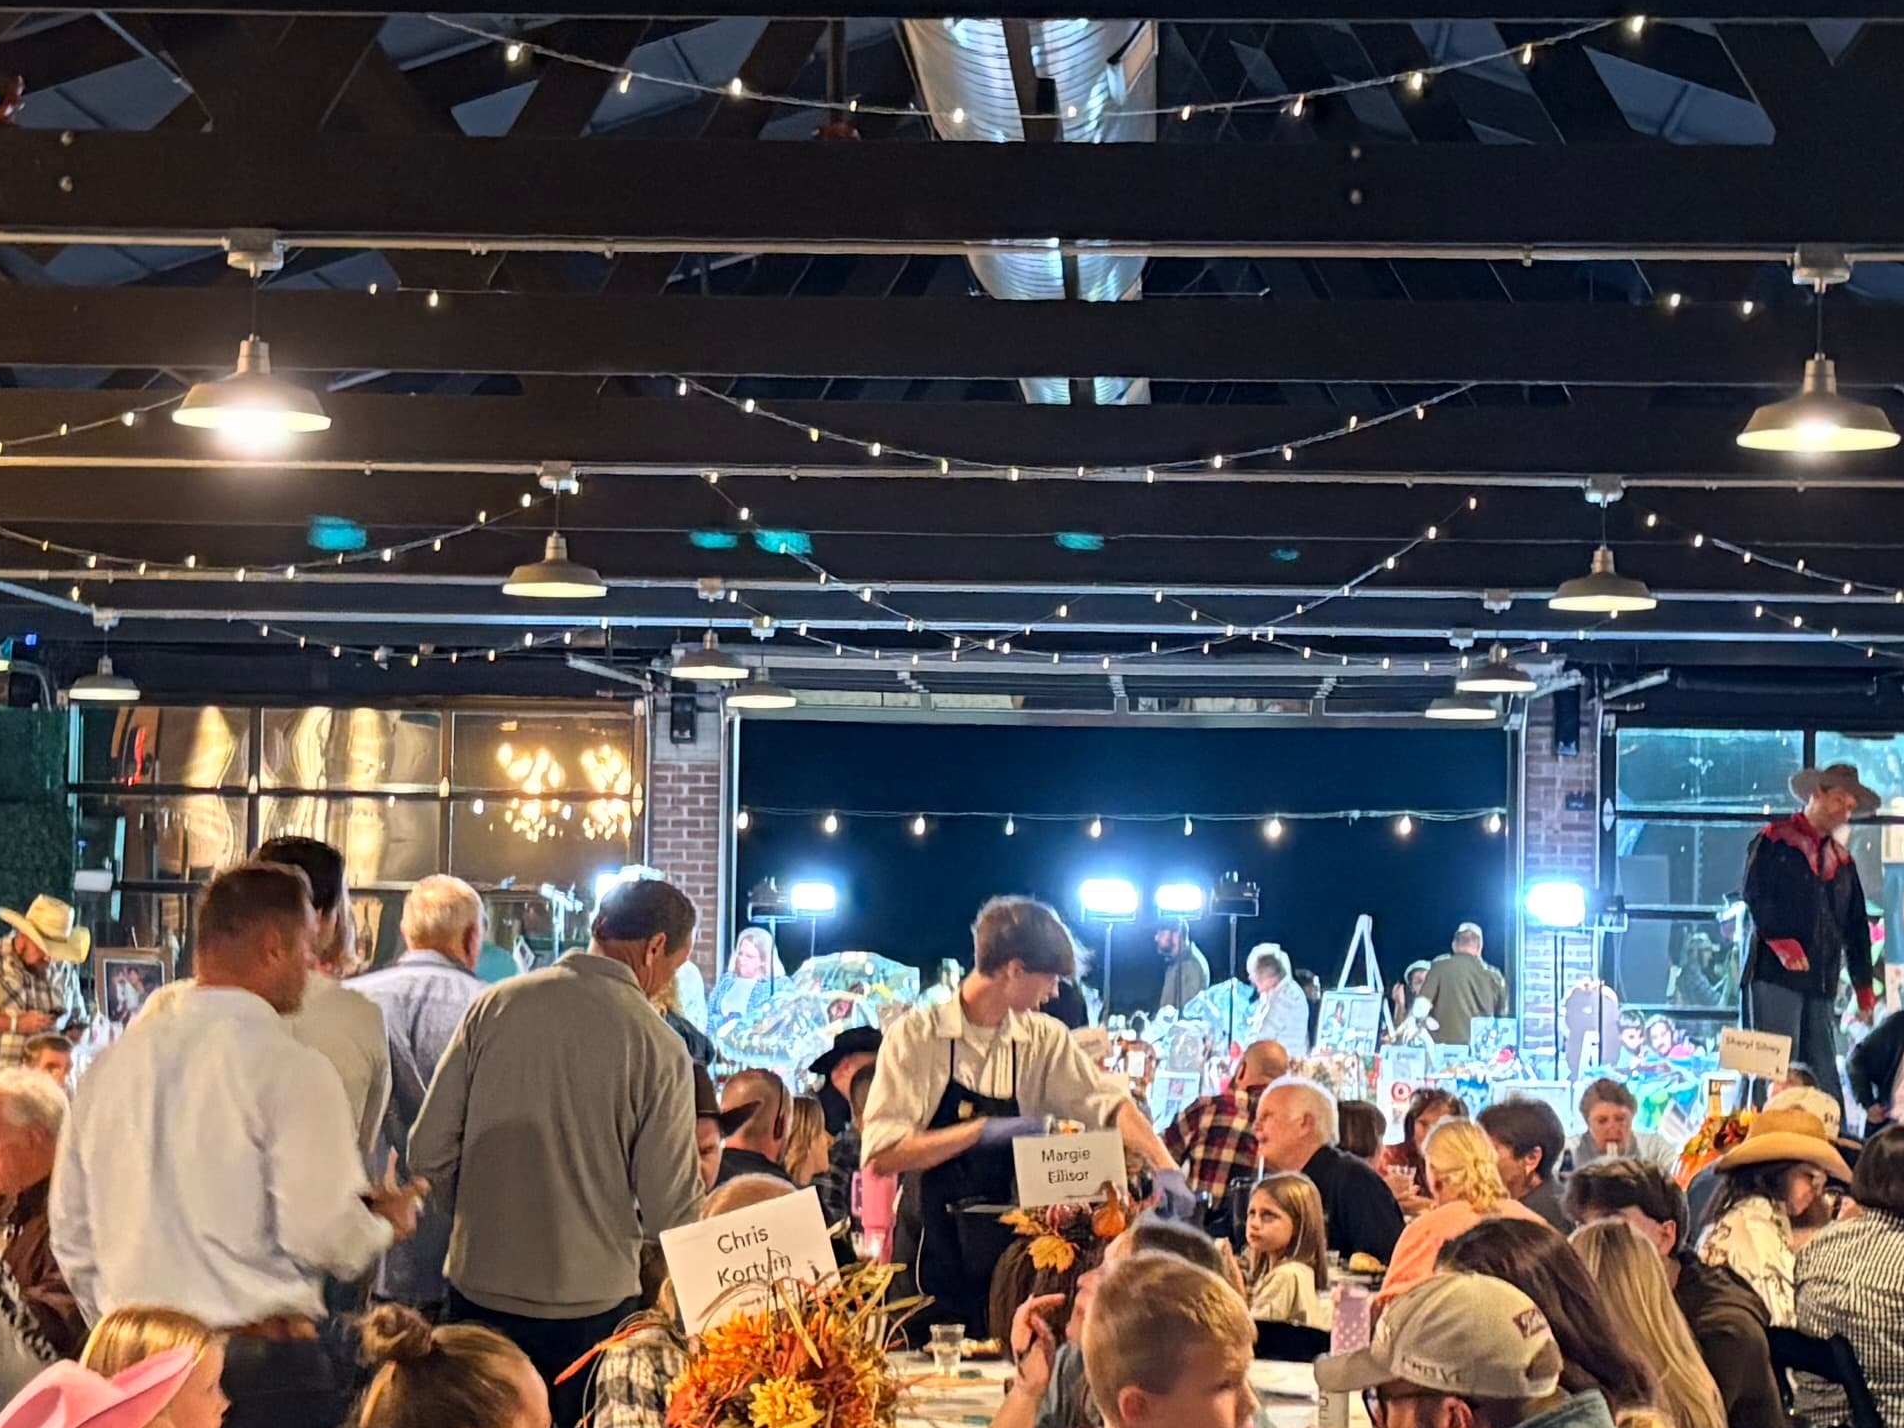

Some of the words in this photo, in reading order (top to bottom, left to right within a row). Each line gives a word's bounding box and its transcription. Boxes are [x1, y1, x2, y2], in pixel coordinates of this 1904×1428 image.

[1041, 1148, 1092, 1164] Margie
[716, 1225, 770, 1254] Chris
[716, 1254, 793, 1287] Kortum
